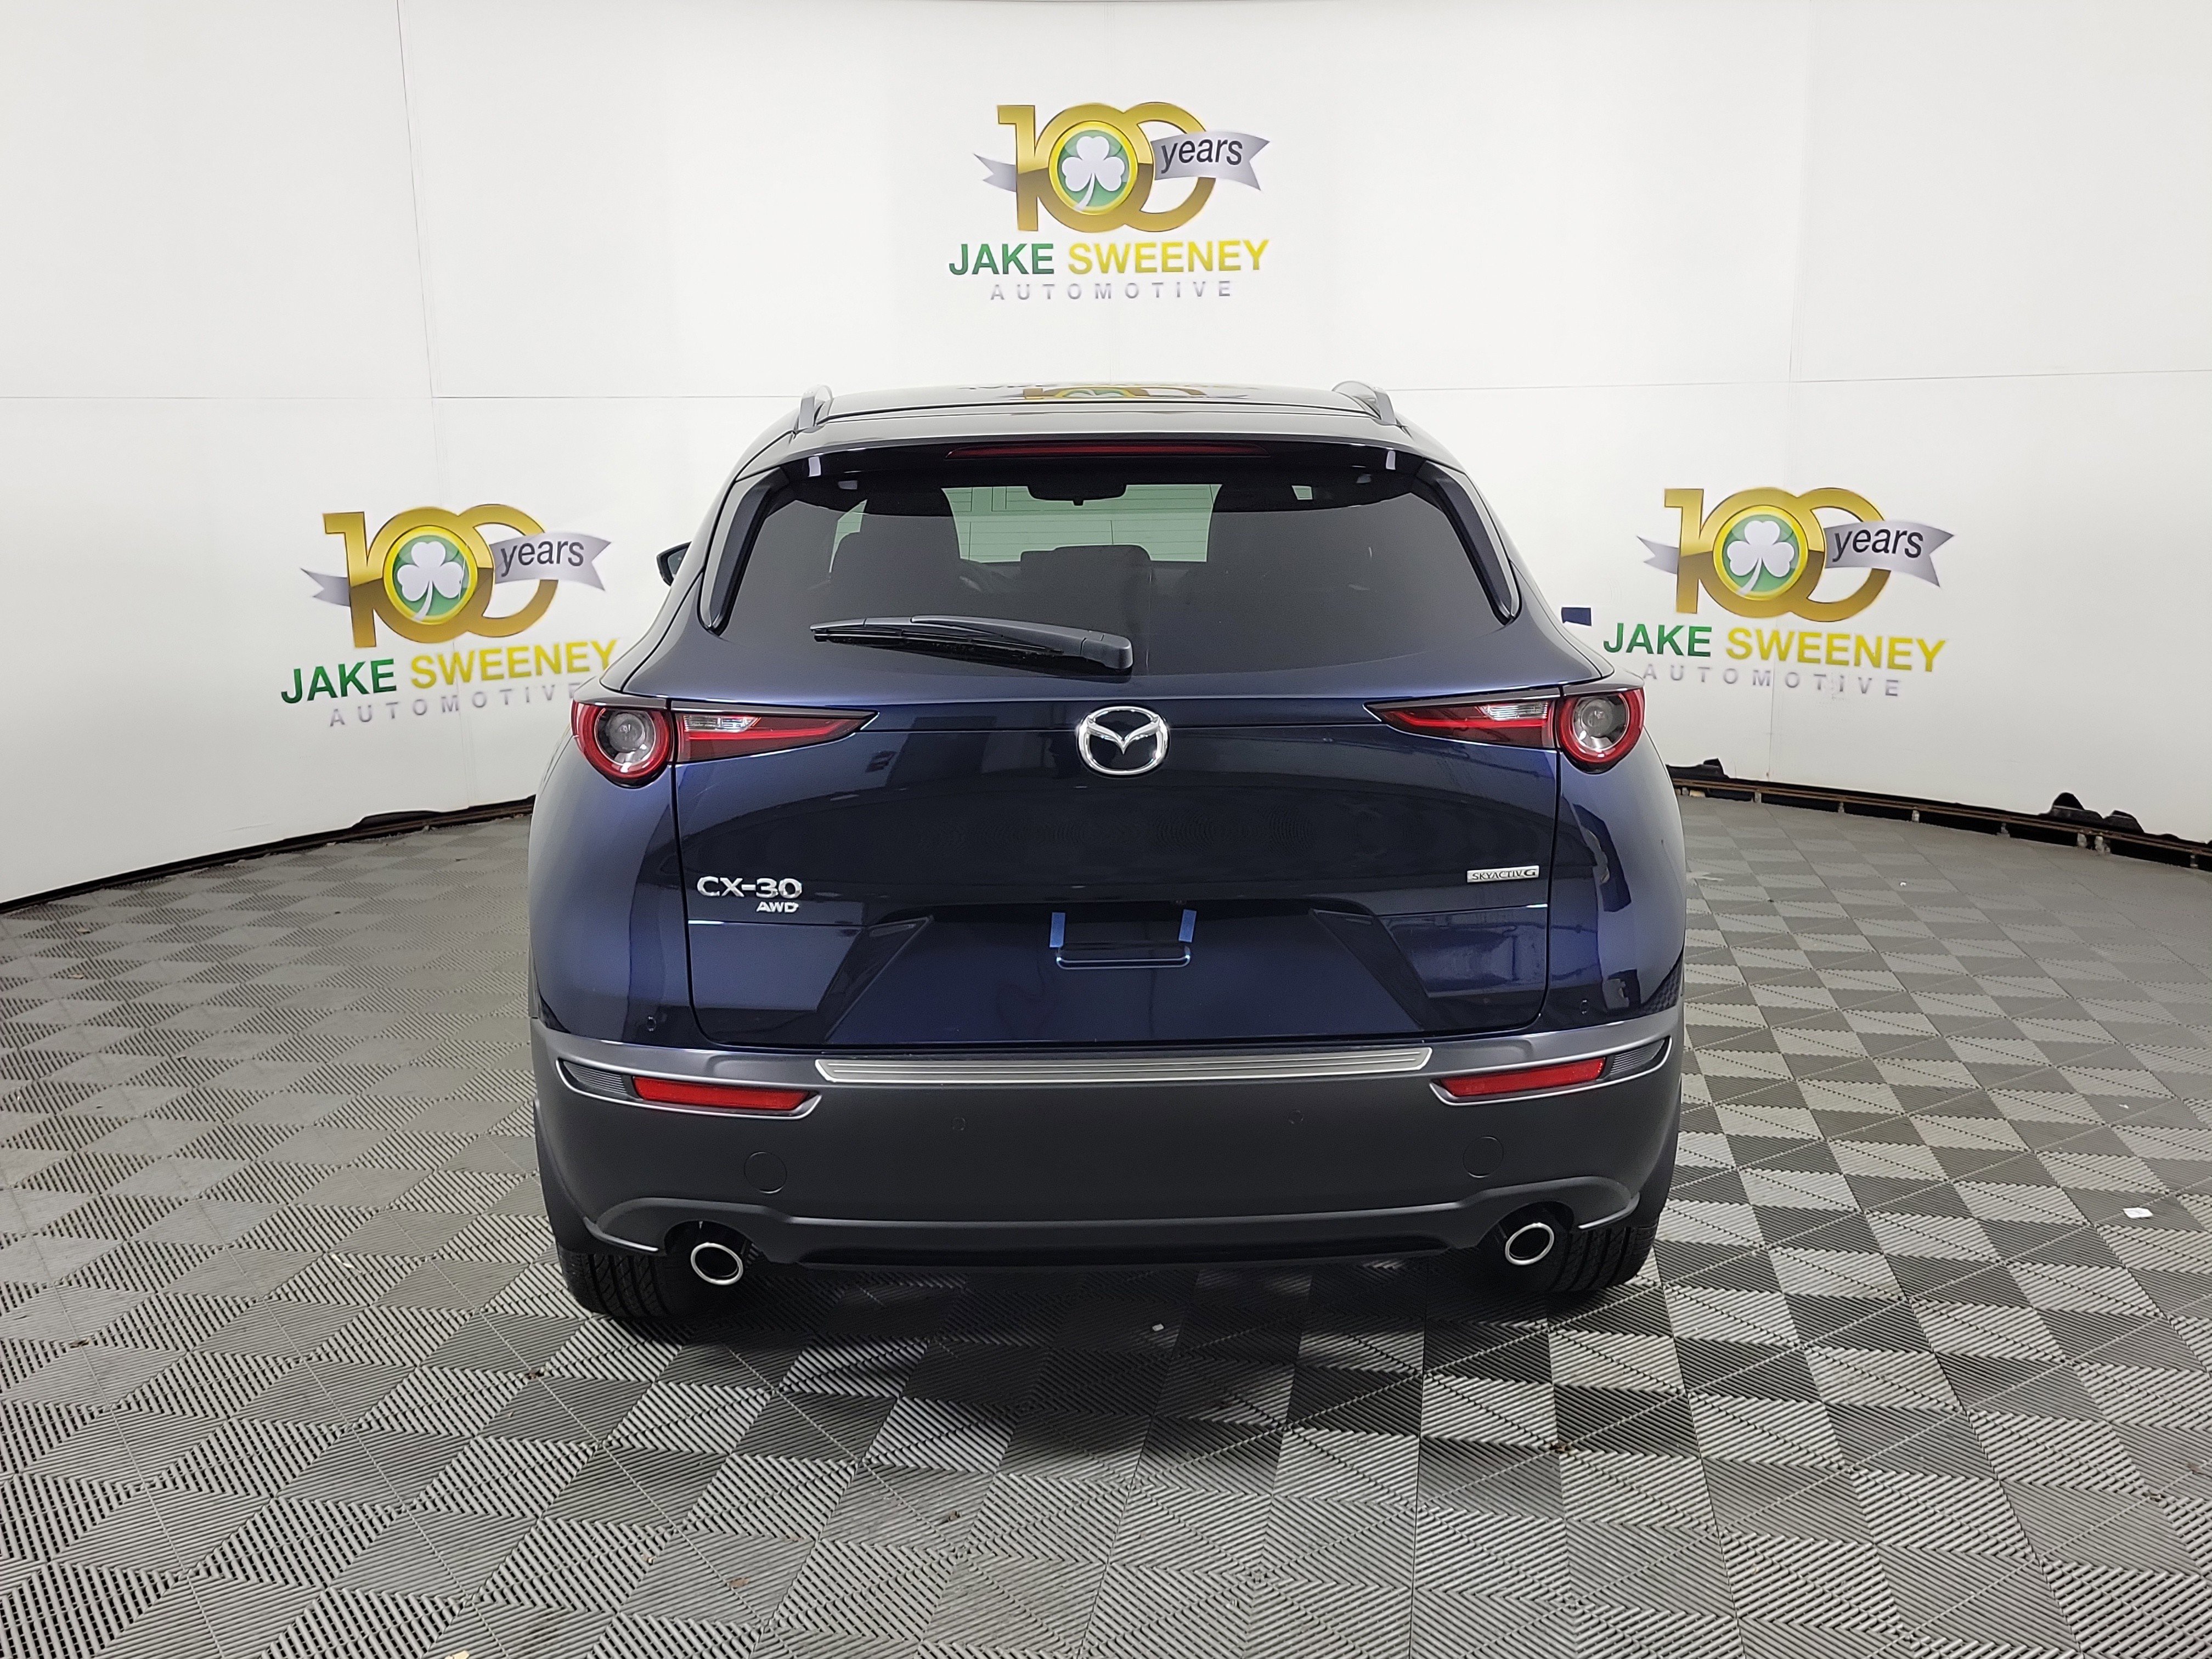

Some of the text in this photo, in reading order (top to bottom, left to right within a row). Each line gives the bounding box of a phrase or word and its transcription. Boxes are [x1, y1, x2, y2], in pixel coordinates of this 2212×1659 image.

[996, 101, 1243, 233] 100 years
[949, 240, 1269, 275] JAKE SWEENEY
[990, 280, 1231, 300] AUTOMOTIVE
[322, 503, 584, 648] 100 years
[1664, 487, 1924, 622] 100 years
[1603, 623, 1946, 672] JAKE SWEENEY
[281, 639, 618, 704] JAKE SWEENEY
[1643, 664, 1899, 696] AUTOMOTIVE
[697, 876, 802, 899] CX-30
[756, 901, 799, 912] AWD
